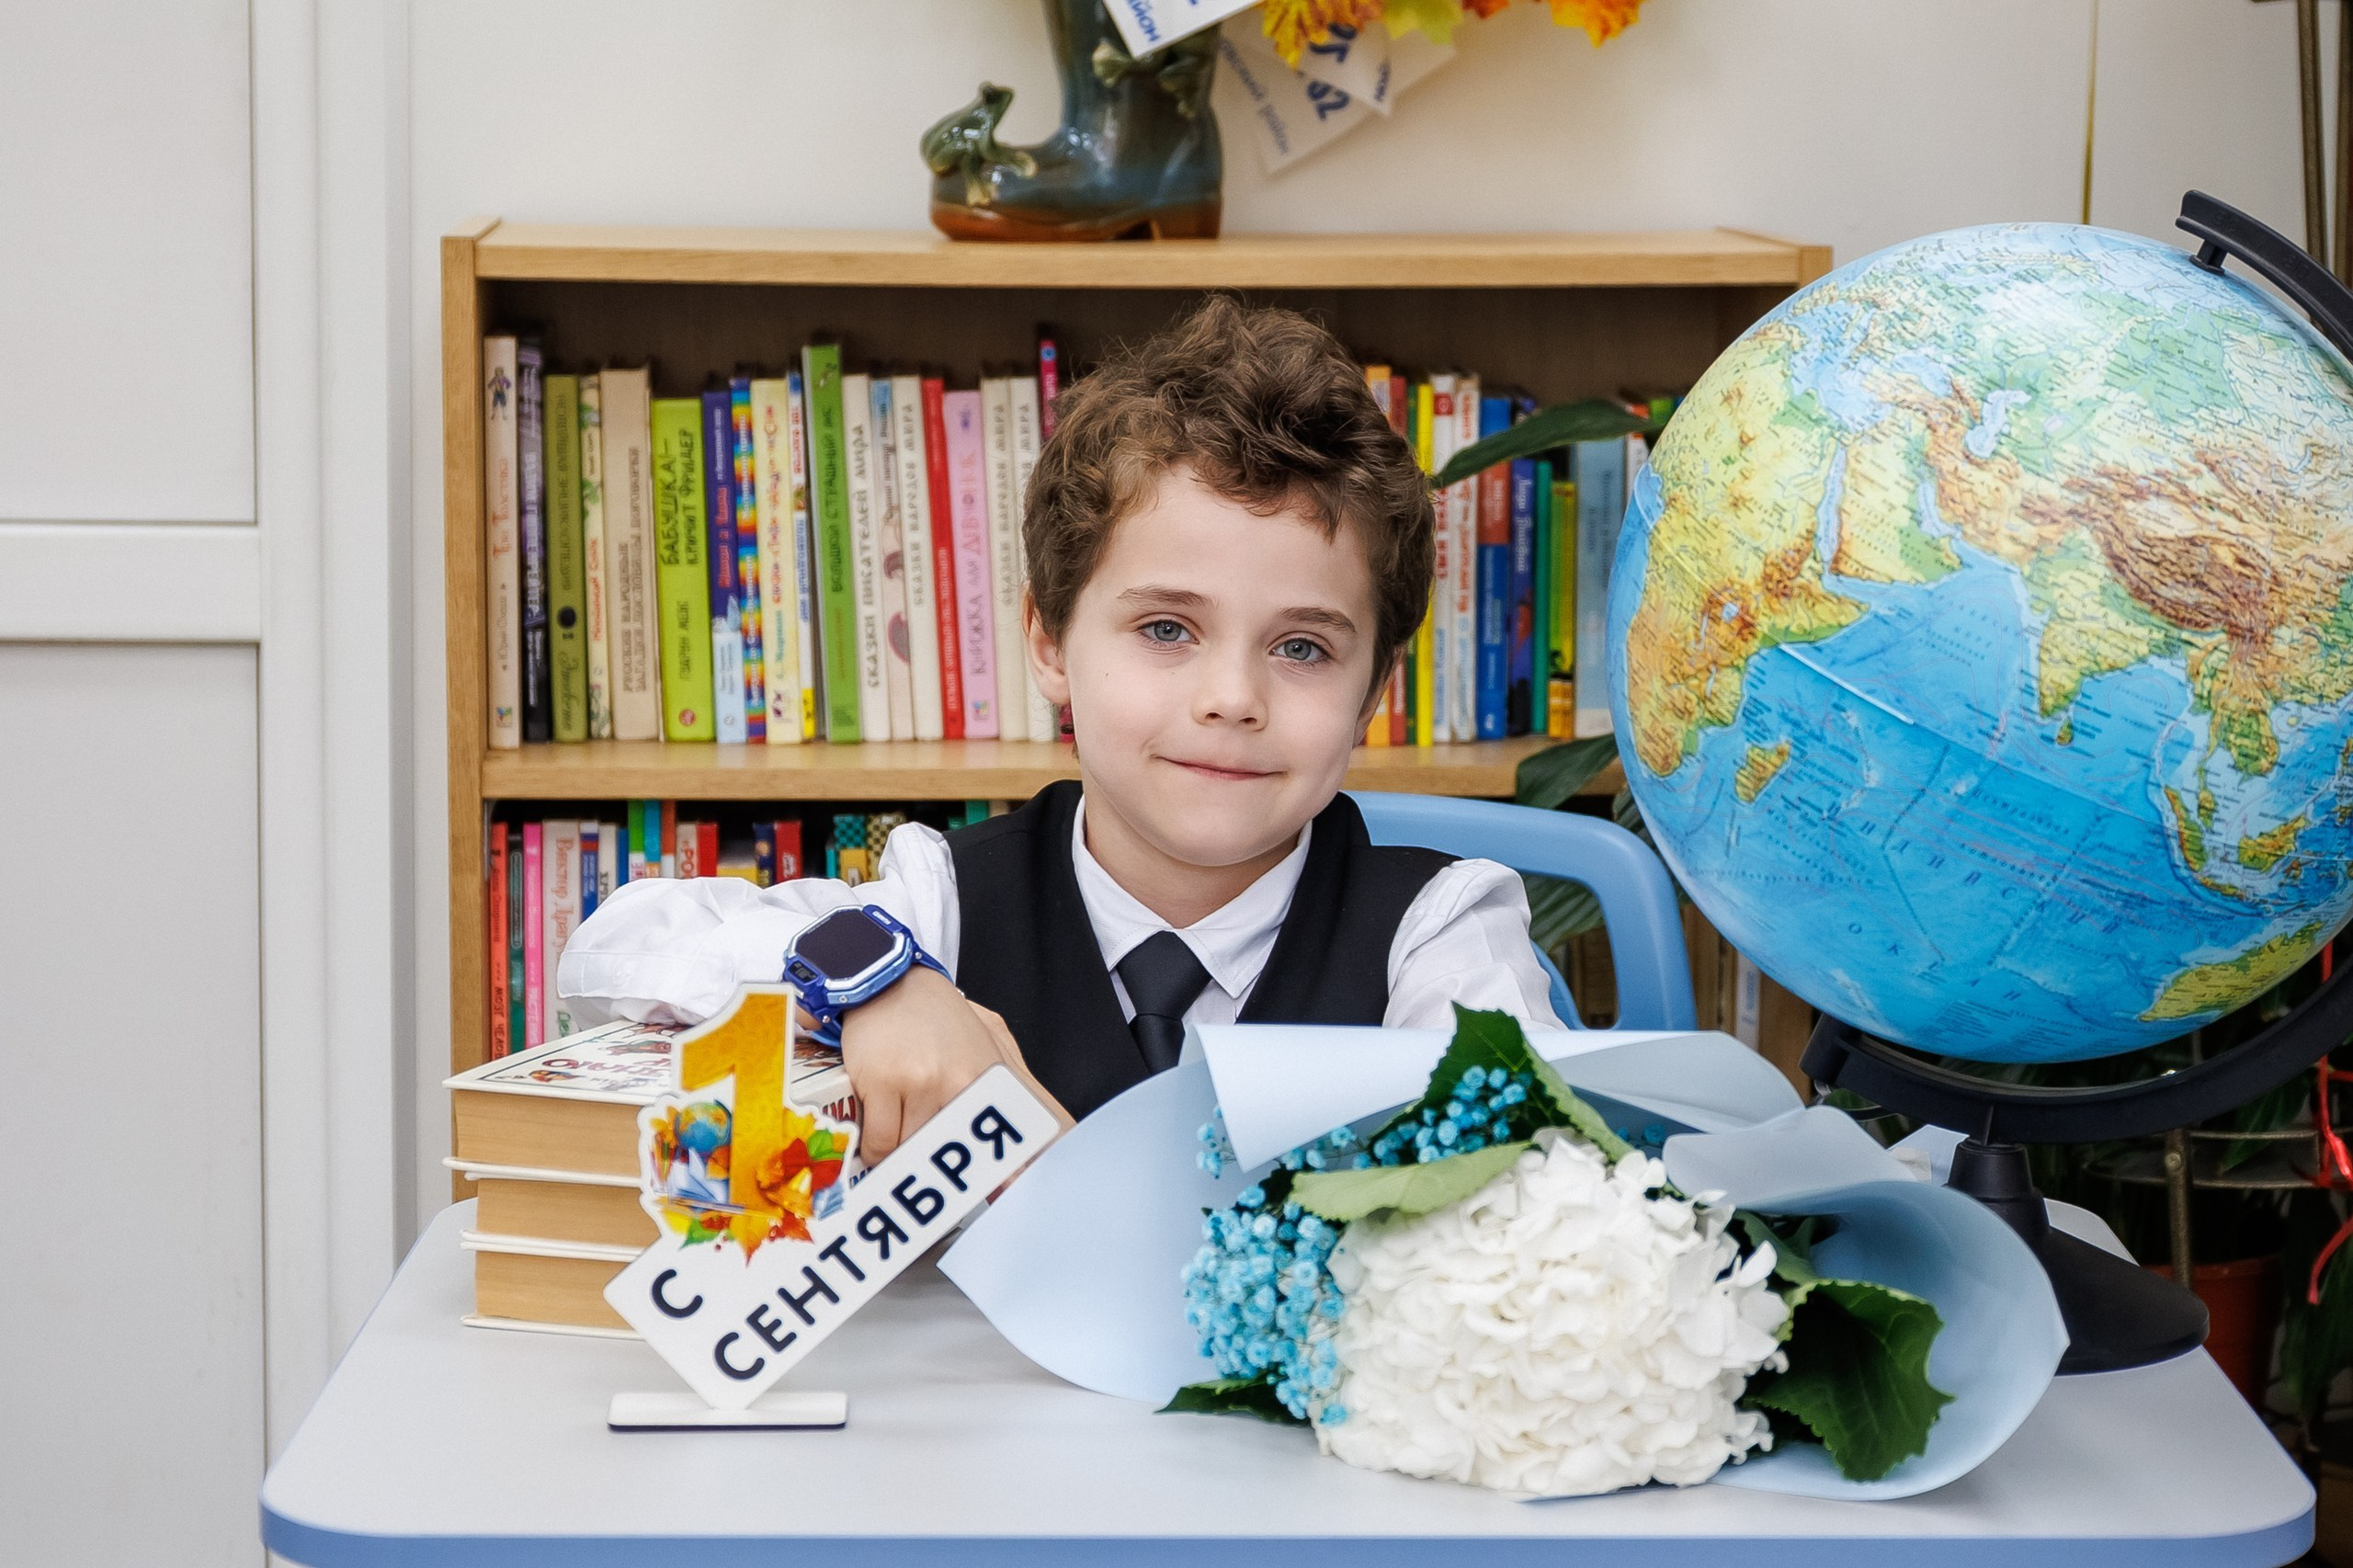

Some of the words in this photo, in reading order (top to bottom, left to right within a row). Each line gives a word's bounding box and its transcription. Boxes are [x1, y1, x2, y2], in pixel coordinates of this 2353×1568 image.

[855, 490, 875, 606] ПИСАТЕЛЕЙ
[863, 615, 880, 688] СКАЗКИ
[551, 837, 574, 899] Виктор
[494, 985, 504, 1017] МОЗГ
[681, 993, 789, 1215] 1
[713, 1104, 1024, 1382] СЕНТЯБРЯ
[651, 1267, 705, 1320] С
